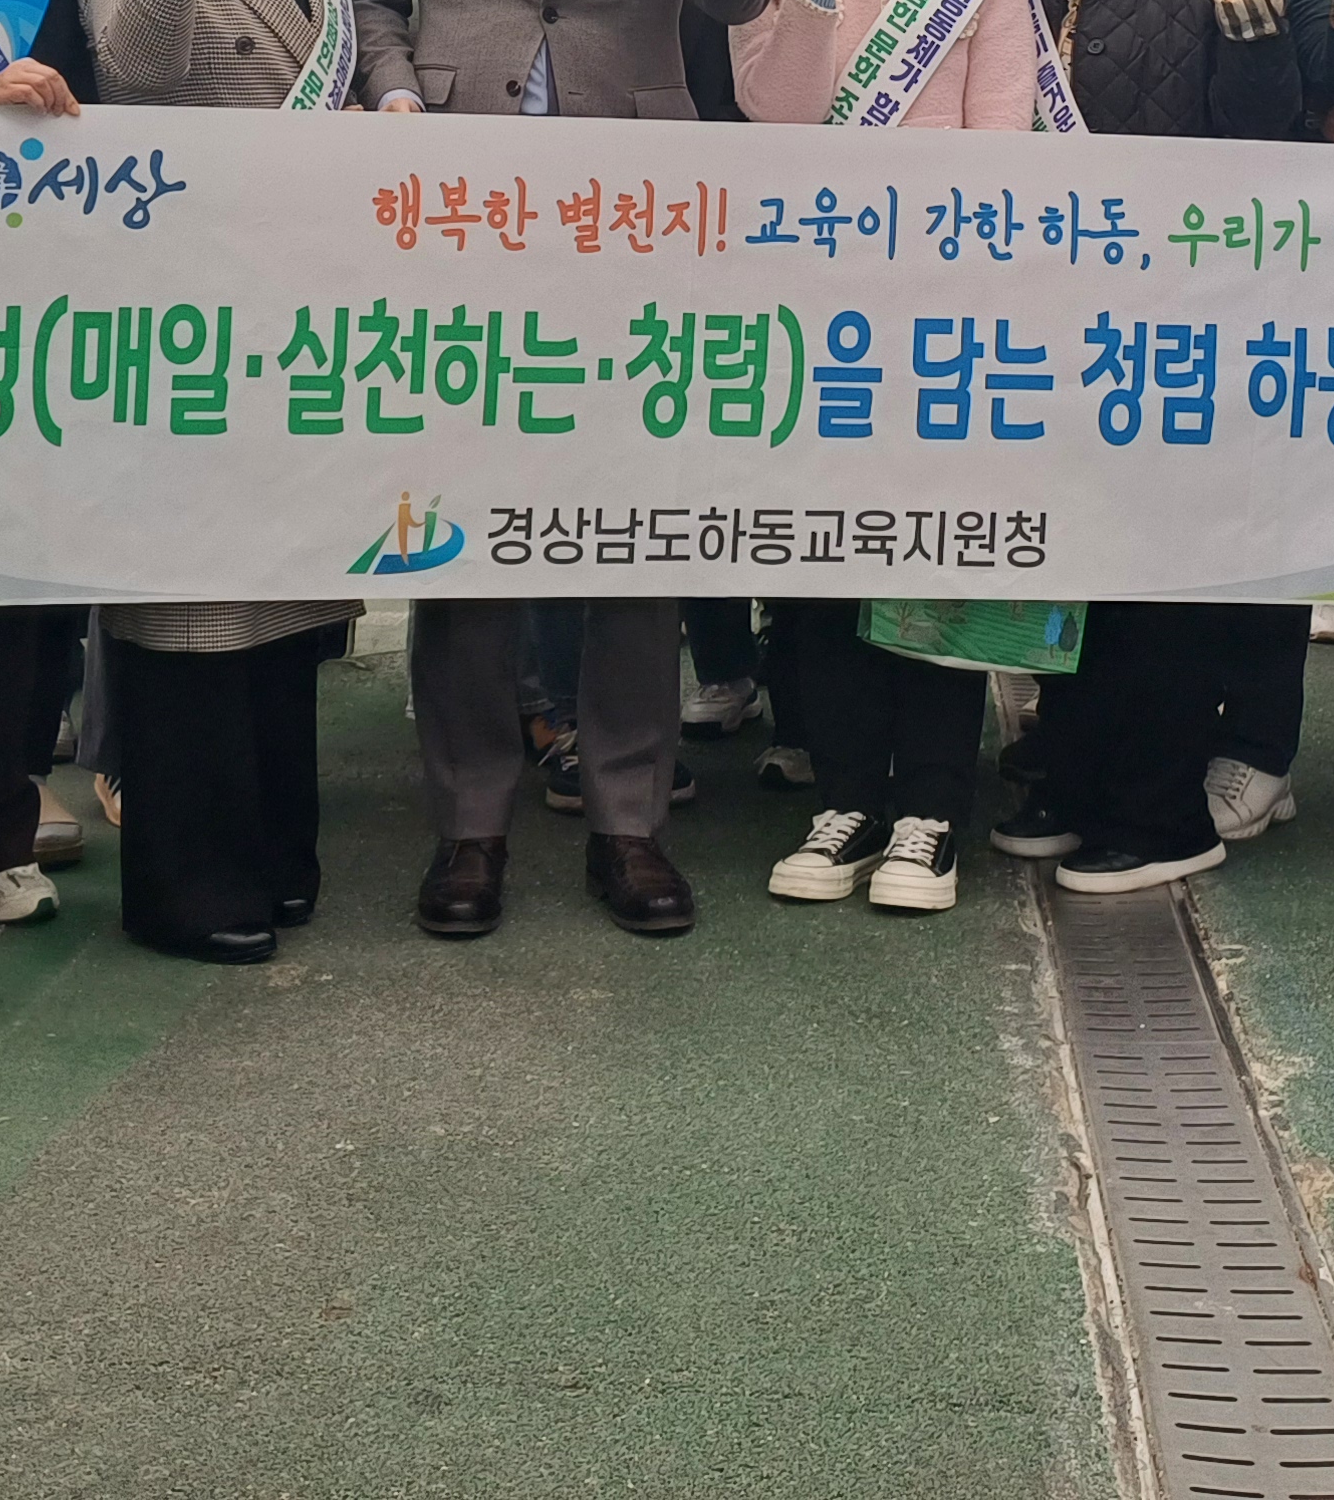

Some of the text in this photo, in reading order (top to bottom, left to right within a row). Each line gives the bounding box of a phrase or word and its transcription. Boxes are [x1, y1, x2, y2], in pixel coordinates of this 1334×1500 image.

[847, 28, 899, 89] 문화
[372, 172, 538, 252] 행복한
[556, 178, 730, 257] 별천지!
[744, 185, 898, 261] 교육이
[924, 186, 1025, 261] 강한
[1038, 190, 1152, 272] 하동,
[1167, 197, 1321, 273] 우리가
[910, 315, 1056, 441] 담는
[1080, 310, 1218, 447] 청렴
[486, 503, 1049, 569] 경상남도하동교육지원청
